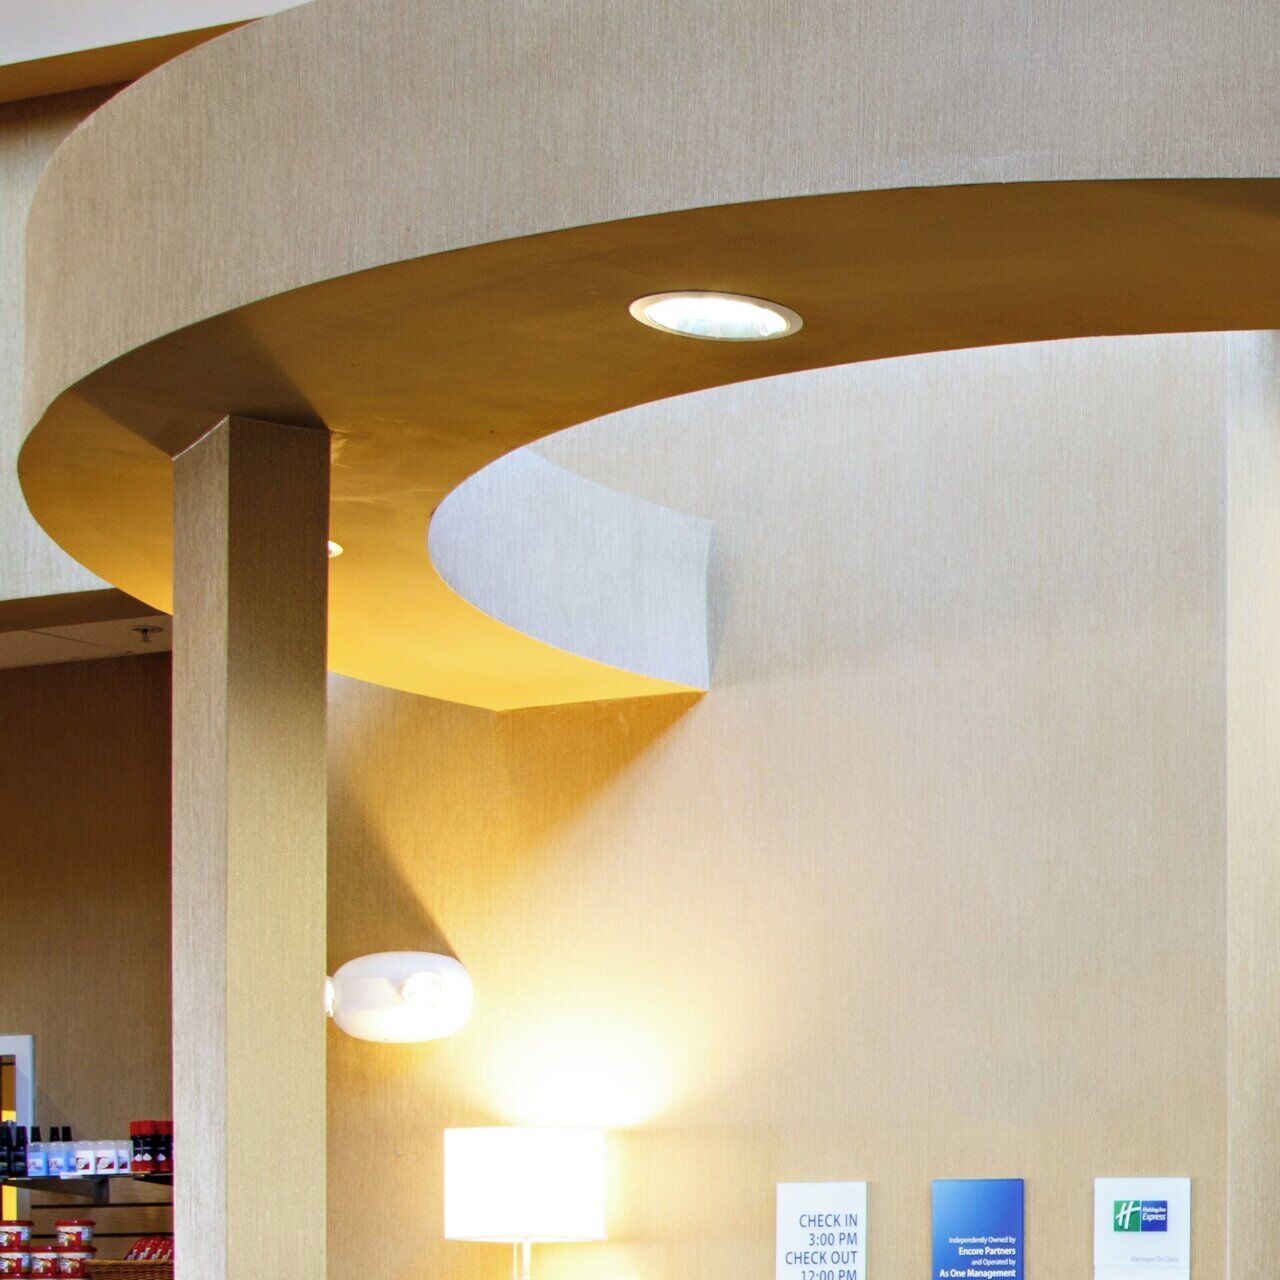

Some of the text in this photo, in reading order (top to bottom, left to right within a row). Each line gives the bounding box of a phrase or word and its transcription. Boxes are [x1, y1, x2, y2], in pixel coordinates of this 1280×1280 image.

[799, 1214, 858, 1227] CHECK IN
[1142, 1213, 1166, 1222] Express
[809, 1232, 857, 1246] 3:00 PM
[1008, 1236, 1016, 1244] by
[958, 1246, 1016, 1255] Encore Partners
[785, 1251, 857, 1265] CHECK OUT
[1008, 1258, 1016, 1266] by
[939, 1269, 1016, 1279] As One Management
